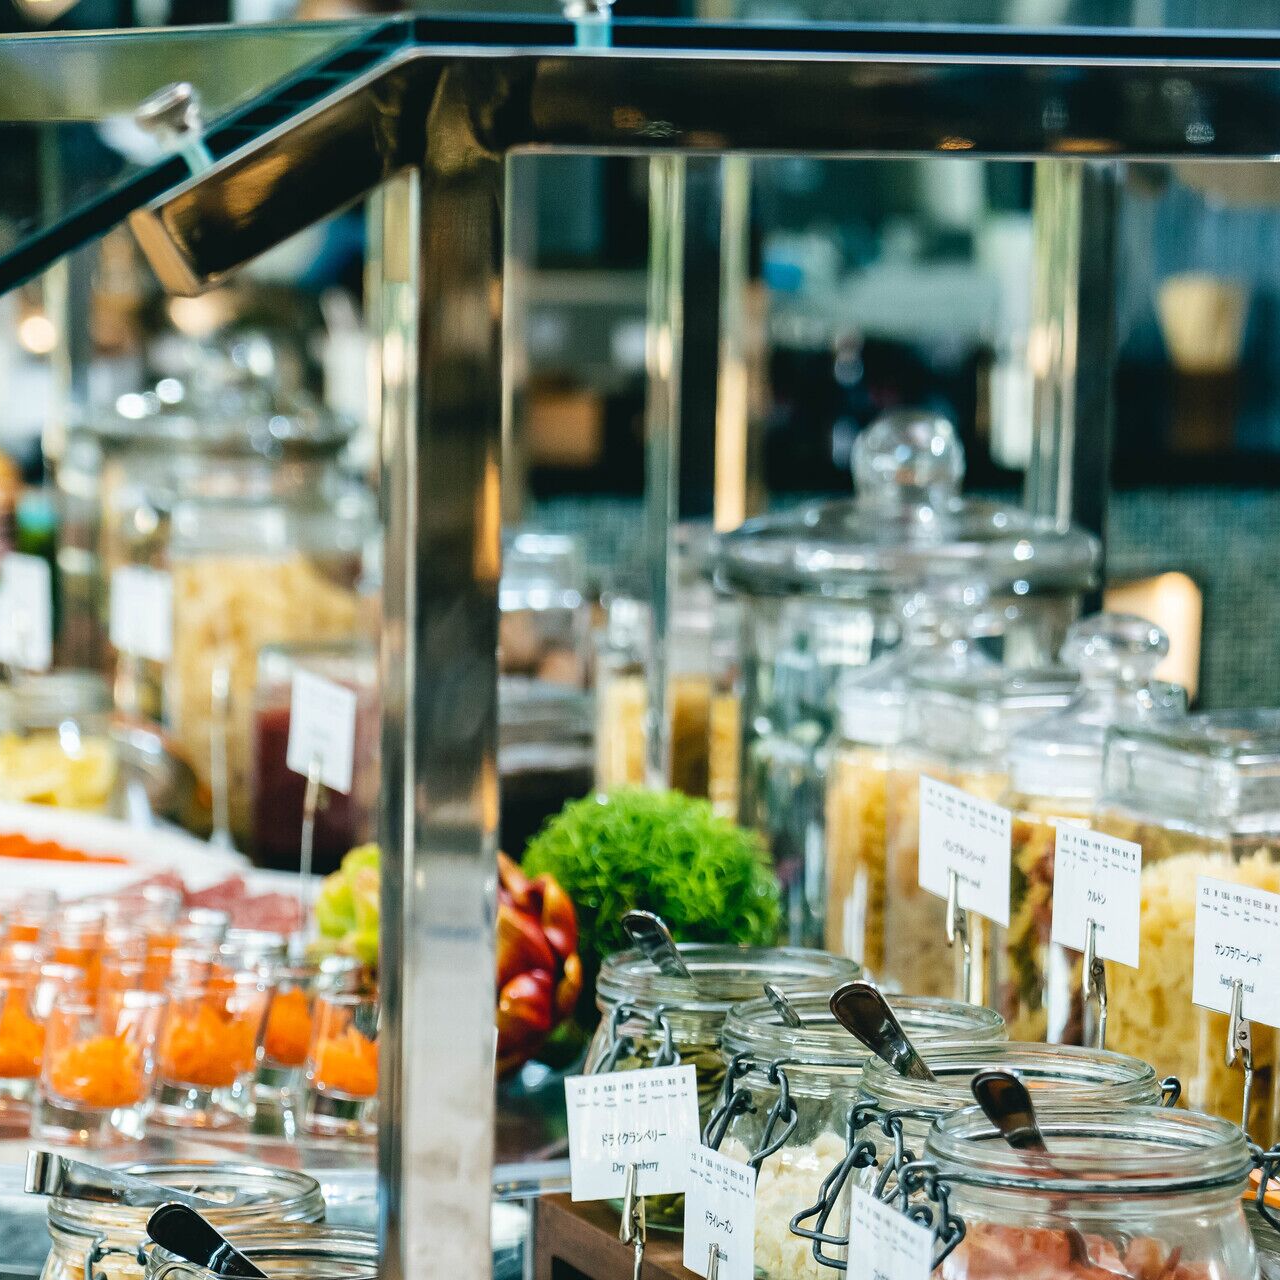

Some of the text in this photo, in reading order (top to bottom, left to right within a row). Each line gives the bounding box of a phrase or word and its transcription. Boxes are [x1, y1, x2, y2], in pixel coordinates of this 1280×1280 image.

[1214, 942, 1263, 967] サンフラワーシード
[600, 1129, 667, 1148] ドライクランベリー
[611, 1162, 626, 1175] Dry
